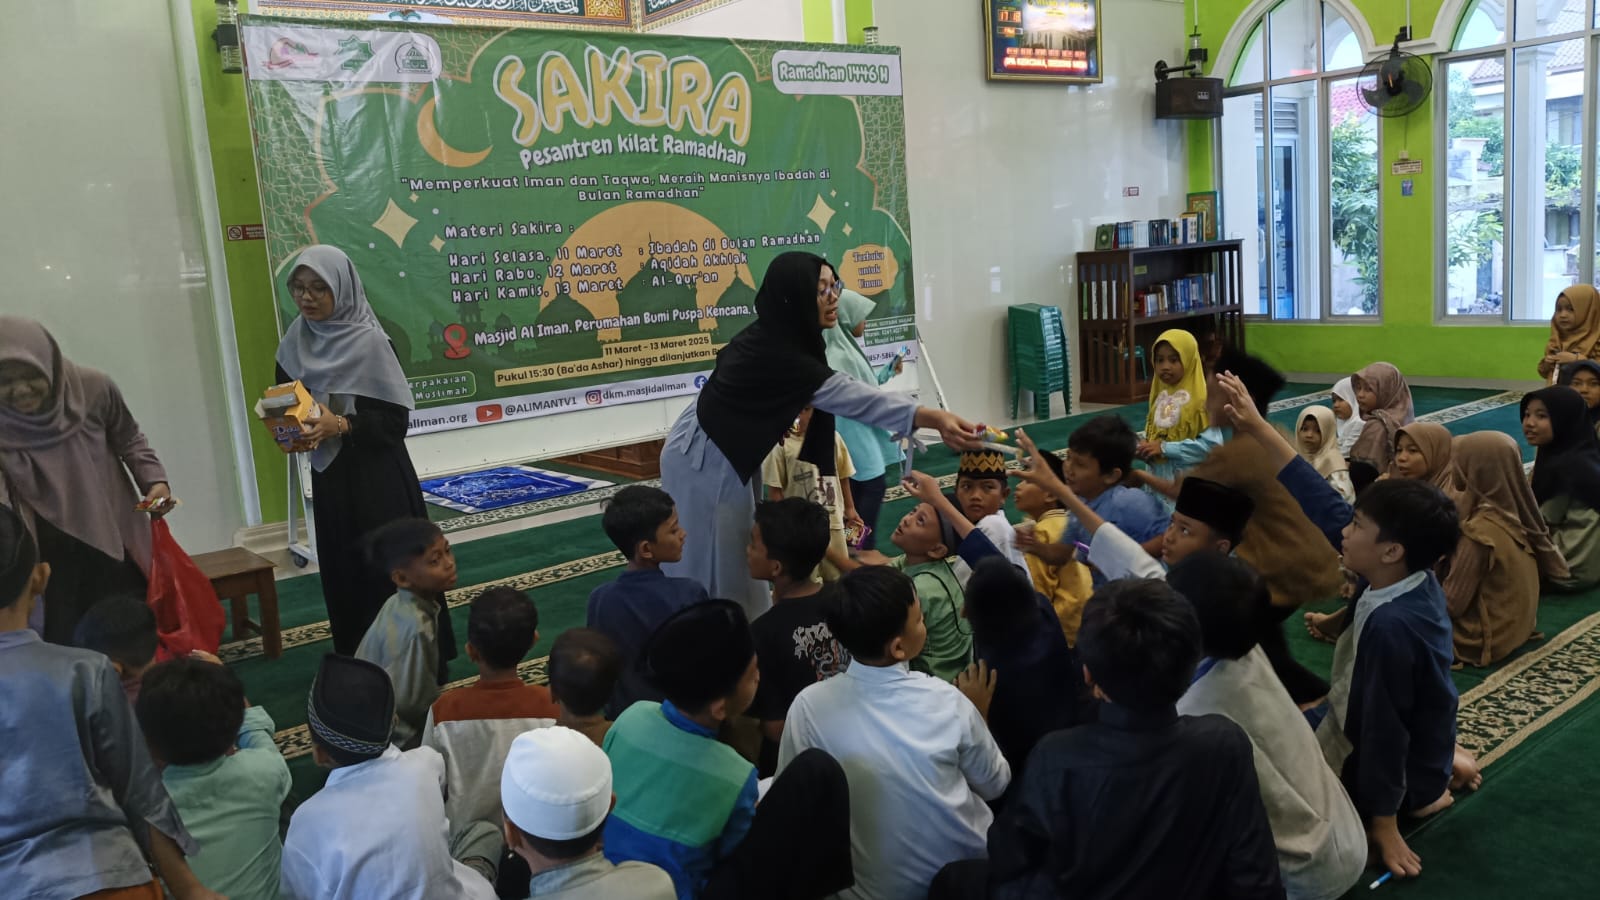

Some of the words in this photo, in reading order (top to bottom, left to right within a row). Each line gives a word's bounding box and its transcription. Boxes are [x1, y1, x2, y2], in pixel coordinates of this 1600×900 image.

[778, 61, 847, 82] Ramadhan
[847, 64, 878, 83] 1446
[879, 65, 889, 84] H
[493, 45, 752, 147] SAKIRA
[519, 137, 613, 170] Pesantren
[662, 134, 747, 167] Ramadhan
[401, 175, 519, 192] "Memperkuat
[524, 175, 564, 188] Iman
[569, 175, 598, 187] dan
[603, 174, 655, 188] Taqwa,
[659, 172, 705, 185] Meraih
[709, 171, 770, 184] Manisnya
[774, 170, 816, 181] Ibadah
[819, 169, 830, 180] di
[578, 190, 621, 201] Bulan
[626, 186, 704, 200] Ramadhan"
[445, 223, 503, 239] Materi
[511, 221, 562, 236] Sakira
[449, 252, 486, 267] Hari
[557, 247, 569, 260] 11
[576, 244, 622, 260] Maret
[649, 240, 697, 255] Ibadah
[703, 238, 715, 251] di
[721, 237, 756, 250] Bulan
[762, 232, 820, 247] Ramadhan
[451, 269, 488, 285] Hari
[548, 264, 564, 278] 12
[571, 261, 617, 276] Maret
[651, 255, 698, 272] Aqidah
[704, 252, 748, 266] Akhlak
[452, 288, 489, 304] Hari
[555, 281, 571, 295] 13
[578, 278, 623, 294] Maret
[652, 271, 719, 287] Al-Qur'an
[474, 327, 517, 347] Masjid
[520, 325, 535, 339] Al
[574, 314, 640, 332] Perumahan
[643, 310, 670, 324] Bumi
[672, 307, 704, 323] Puspa
[605, 347, 613, 356] 11
[614, 344, 642, 355] Maret
[650, 342, 659, 351] 13
[660, 339, 687, 350] Maret
[688, 336, 710, 346] 2025
[497, 369, 528, 383] Pukul
[529, 366, 555, 380] 15:30
[591, 358, 624, 373] Ashar)
[625, 354, 658, 369] hingga
[660, 349, 711, 364] dilanjutkan
[408, 375, 467, 389] erpakaian
[416, 387, 468, 400] Muslimah
[603, 381, 687, 400] dkm.masjidaliman
